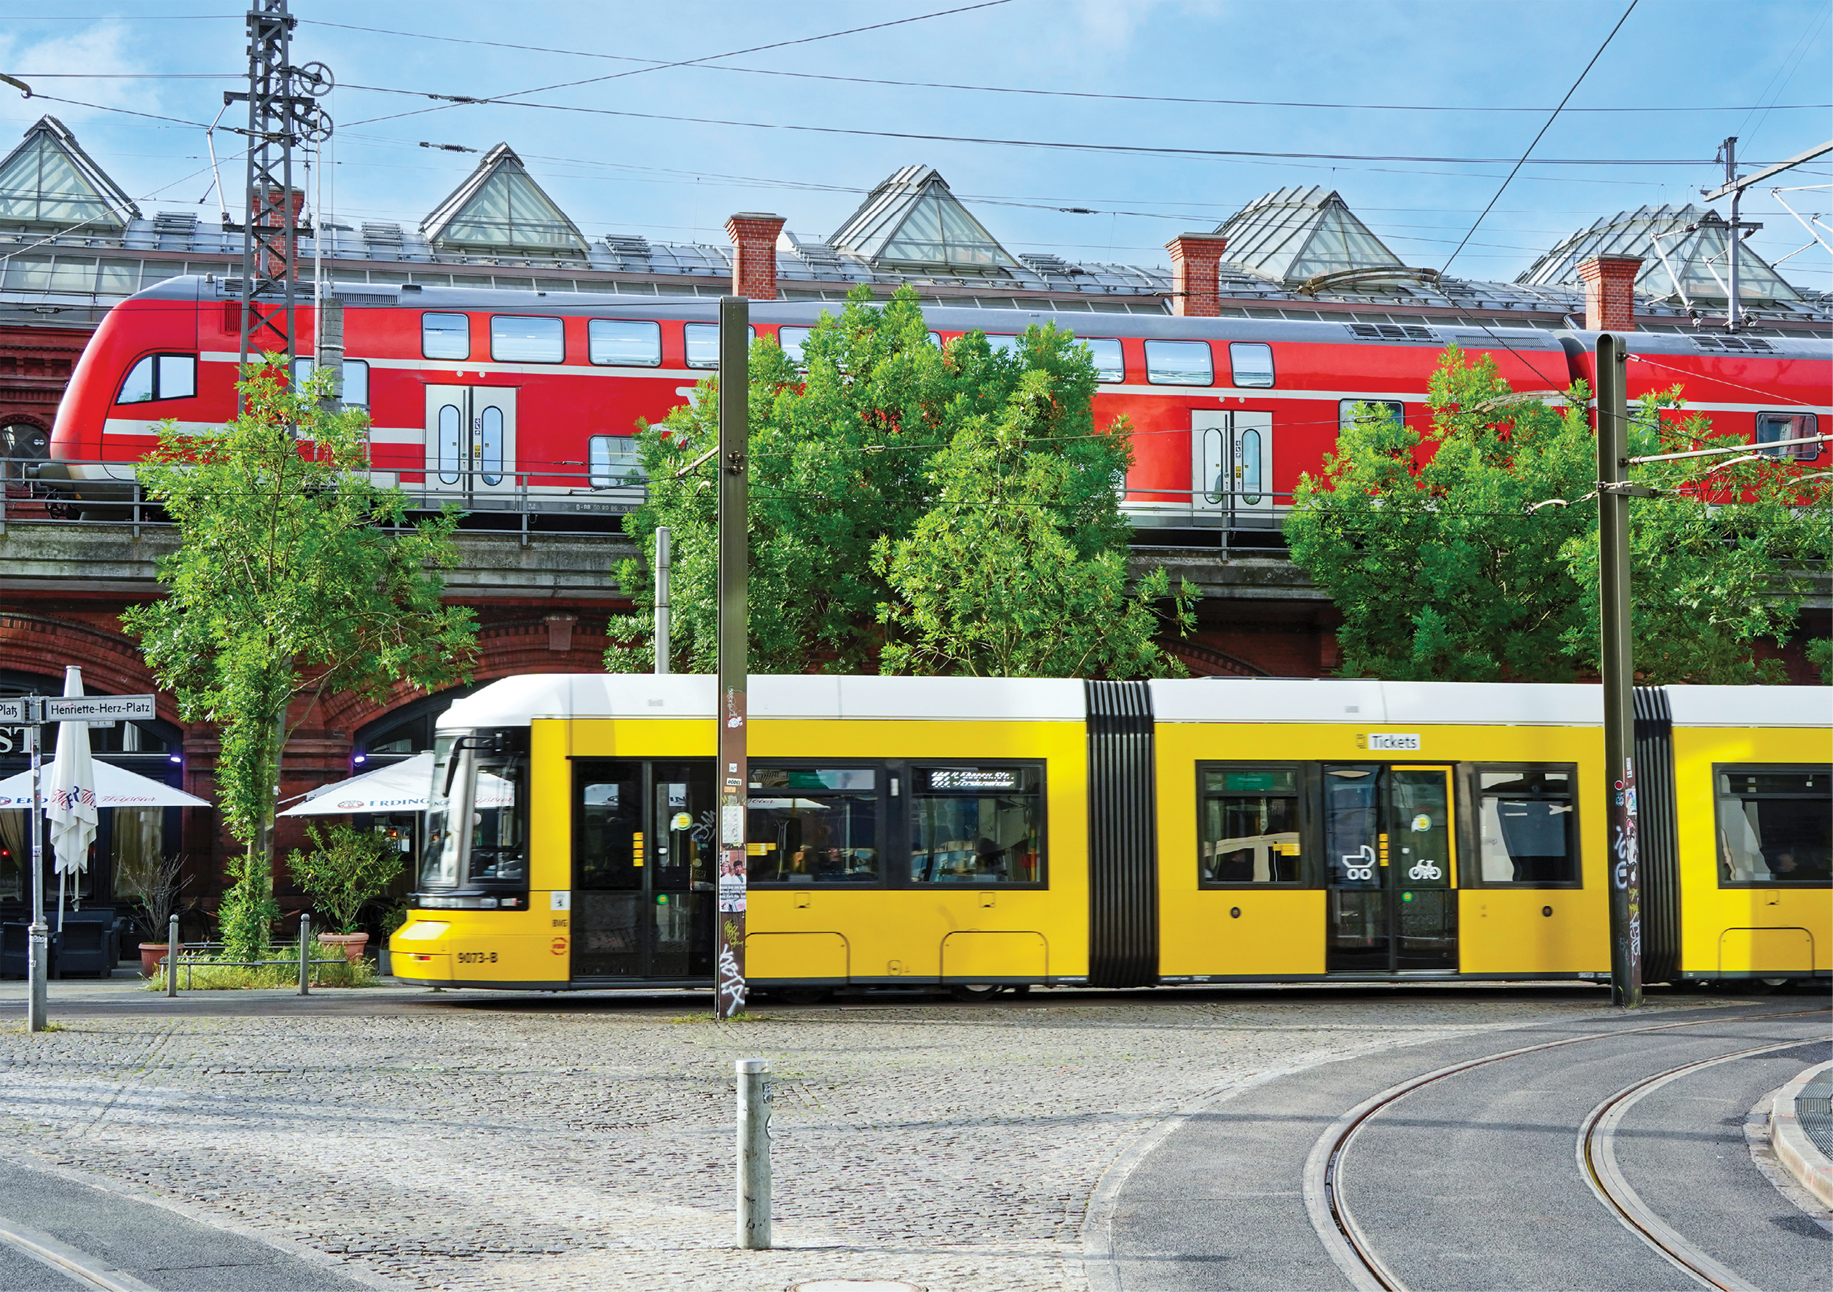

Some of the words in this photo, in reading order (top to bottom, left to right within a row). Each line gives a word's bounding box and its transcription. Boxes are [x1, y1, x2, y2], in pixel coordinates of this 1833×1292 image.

[51, 702, 150, 715] Henriette-Herz-Platz
[1372, 735, 1417, 748] Tickets
[457, 952, 499, 964] 9073-B
